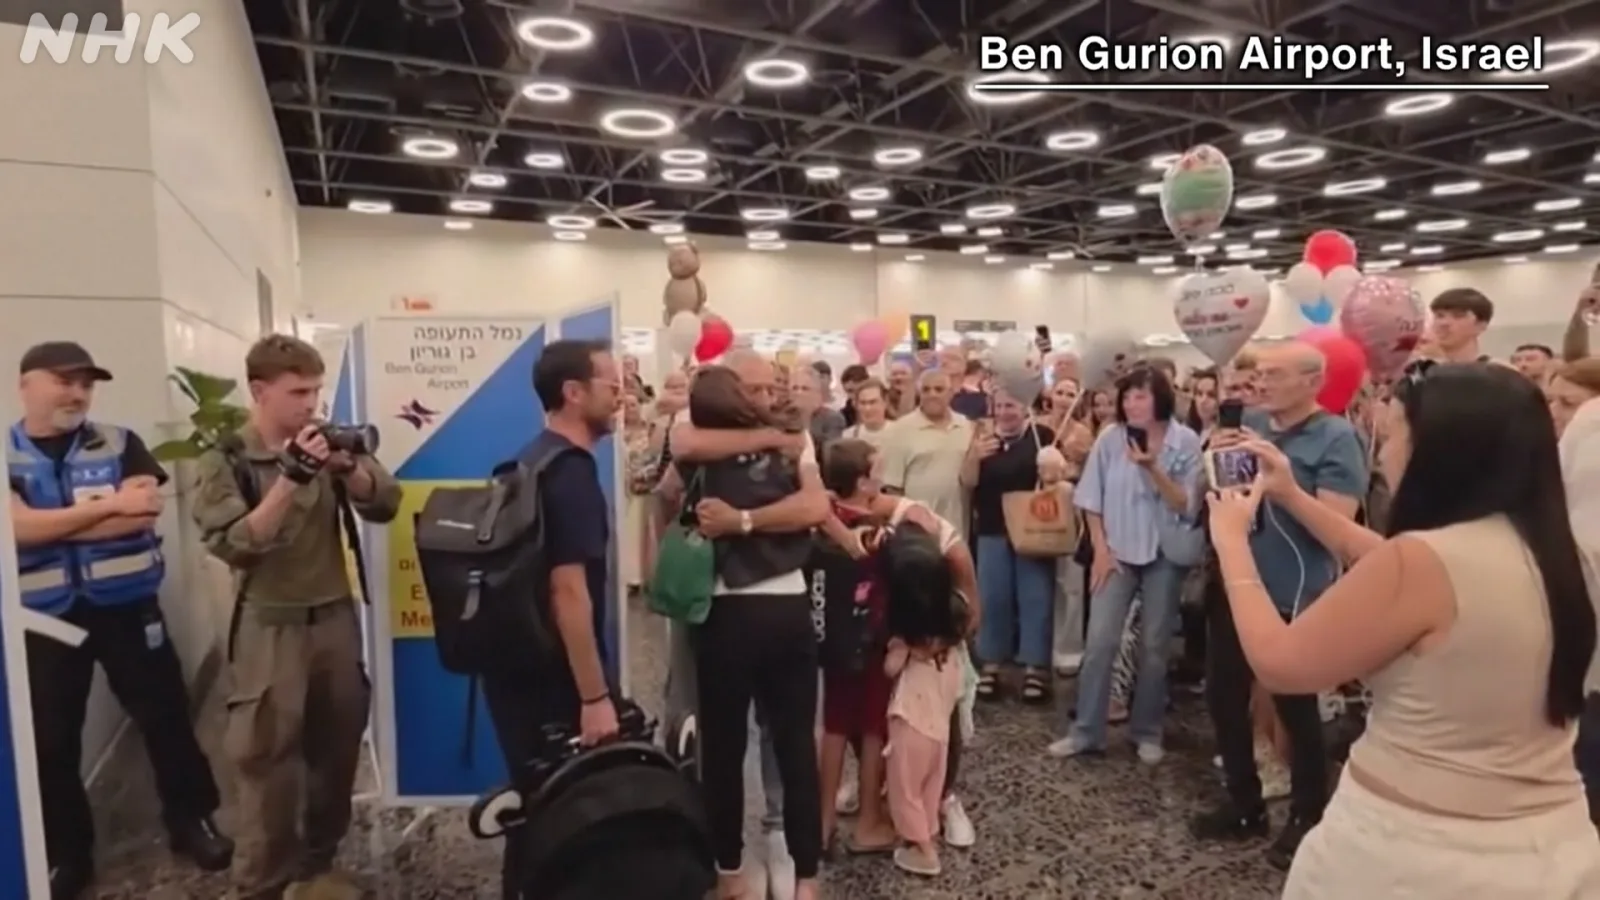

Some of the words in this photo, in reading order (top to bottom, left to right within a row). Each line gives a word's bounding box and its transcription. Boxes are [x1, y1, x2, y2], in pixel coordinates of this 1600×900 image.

[413, 325, 484, 341] התעופה
[488, 324, 522, 341] נמל
[917, 320, 929, 340] 1
[409, 345, 451, 362] גוריון
[460, 345, 476, 362] בן
[384, 361, 412, 375] Ben
[414, 361, 458, 375] Gurion
[427, 377, 470, 391] Airport
